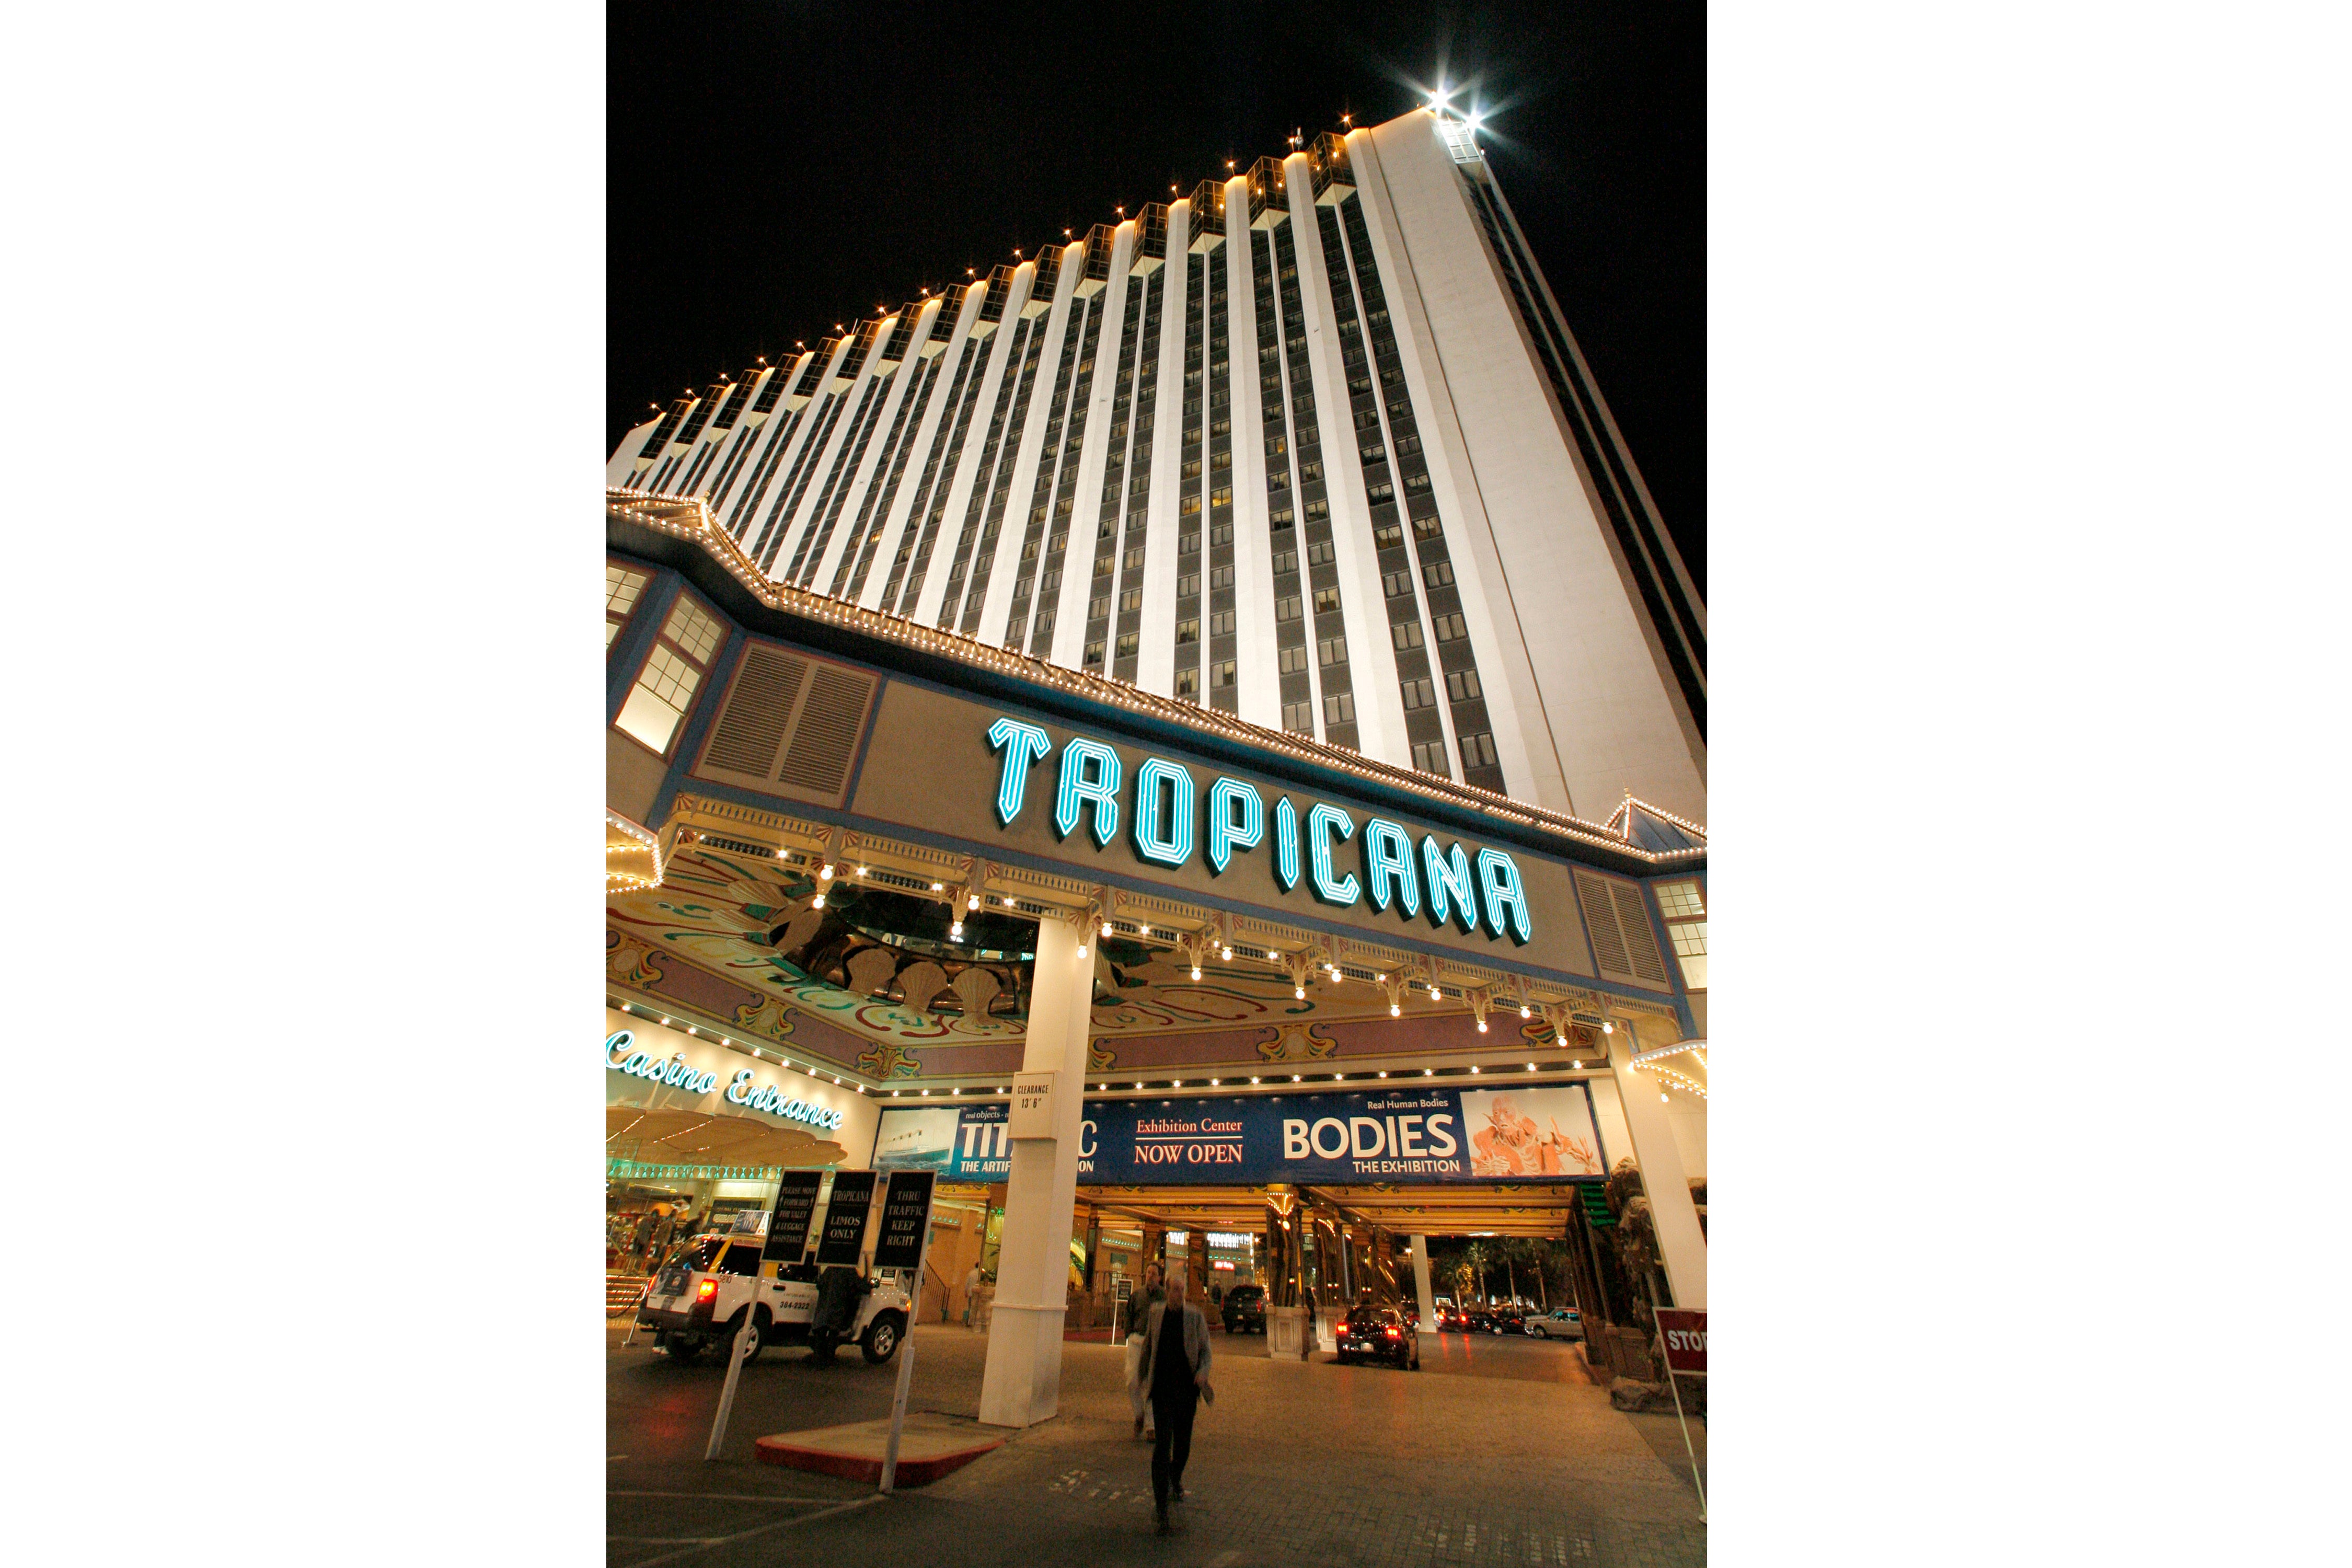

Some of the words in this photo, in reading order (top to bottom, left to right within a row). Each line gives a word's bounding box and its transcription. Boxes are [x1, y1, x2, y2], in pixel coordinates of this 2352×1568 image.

[987, 717, 1531, 943] TROPICANA
[606, 1029, 718, 1094] Casino
[727, 1069, 843, 1131] Entrance
[1017, 1085, 1048, 1094] CLEARANCE
[1022, 1098, 1031, 1108] 13'
[1367, 1100, 1385, 1110] Real
[1387, 1100, 1417, 1109] Human
[1420, 1099, 1448, 1108] Bodies
[976, 1111, 1000, 1120] objects
[1136, 1119, 1197, 1133] Exhibition
[1202, 1118, 1242, 1132] Center
[962, 1120, 1097, 1158] TITC
[1283, 1113, 1457, 1159] BODIES
[1134, 1145, 1184, 1164] NOW
[1187, 1144, 1243, 1163] OPEN
[961, 1161, 979, 1172] THE
[1353, 1161, 1380, 1173] THE
[1381, 1160, 1460, 1172] EXHIBITION
[833, 1190, 870, 1202] TROPICANA
[897, 1191, 921, 1201] THRU
[889, 1205, 925, 1216] TRAFFIC
[830, 1216, 861, 1226] LIMOS
[891, 1220, 915, 1231] KEEP
[830, 1229, 857, 1239] ONLY
[886, 1235, 915, 1246] RIGHT
